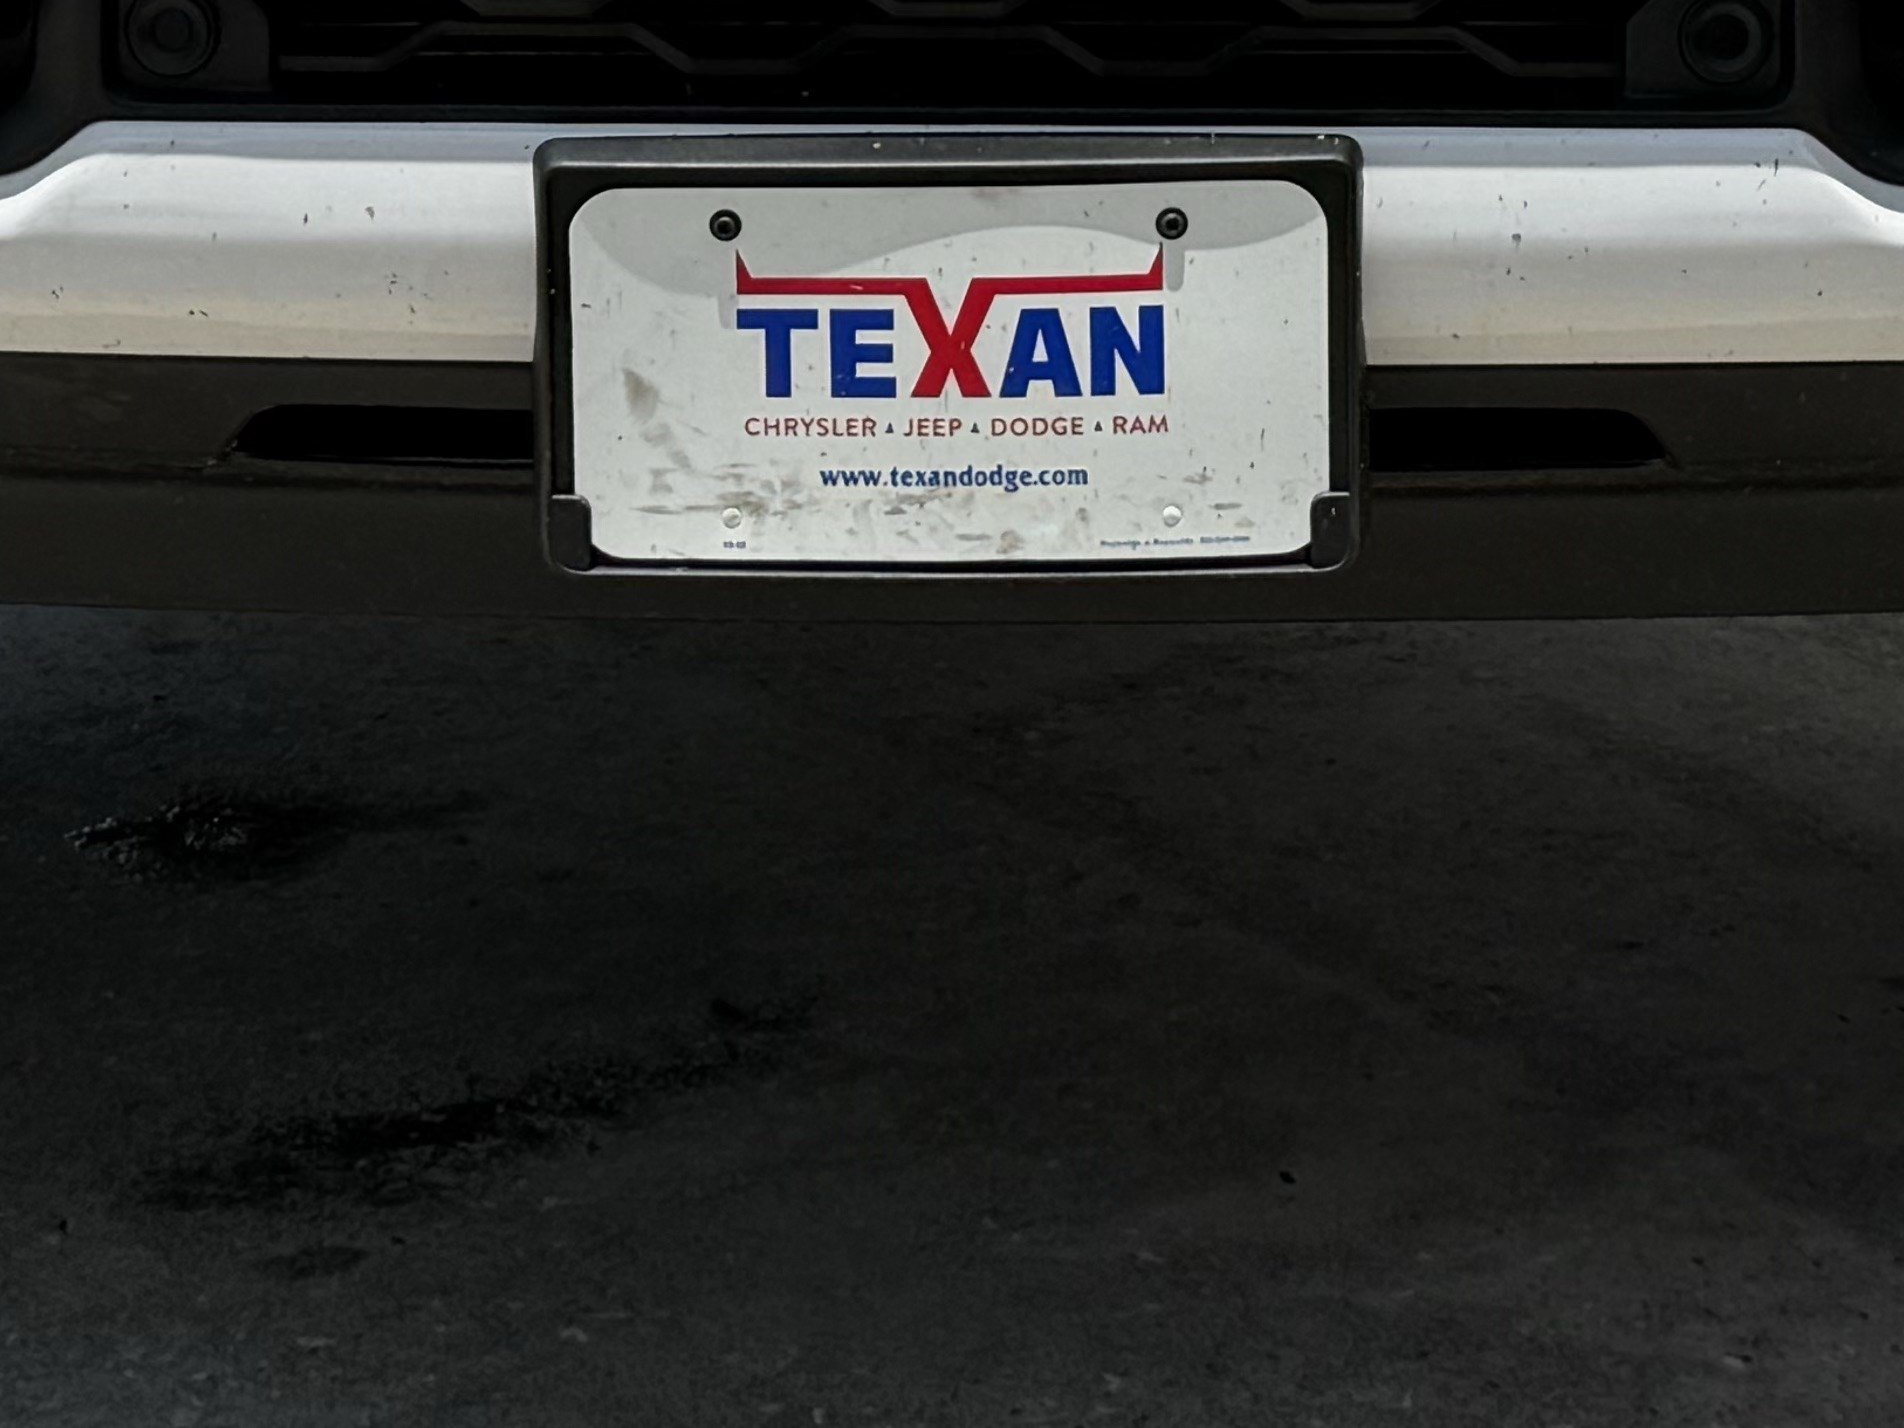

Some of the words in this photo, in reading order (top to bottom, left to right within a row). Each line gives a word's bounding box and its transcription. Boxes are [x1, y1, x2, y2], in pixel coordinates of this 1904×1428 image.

[736, 272, 1165, 399] TEXAN
[744, 417, 878, 437] CHRYSLER
[903, 417, 963, 437] JEEP
[990, 416, 1084, 437] DODGE
[1112, 414, 1169, 435] RAM
[819, 464, 1089, 493] www.texandodge.com
